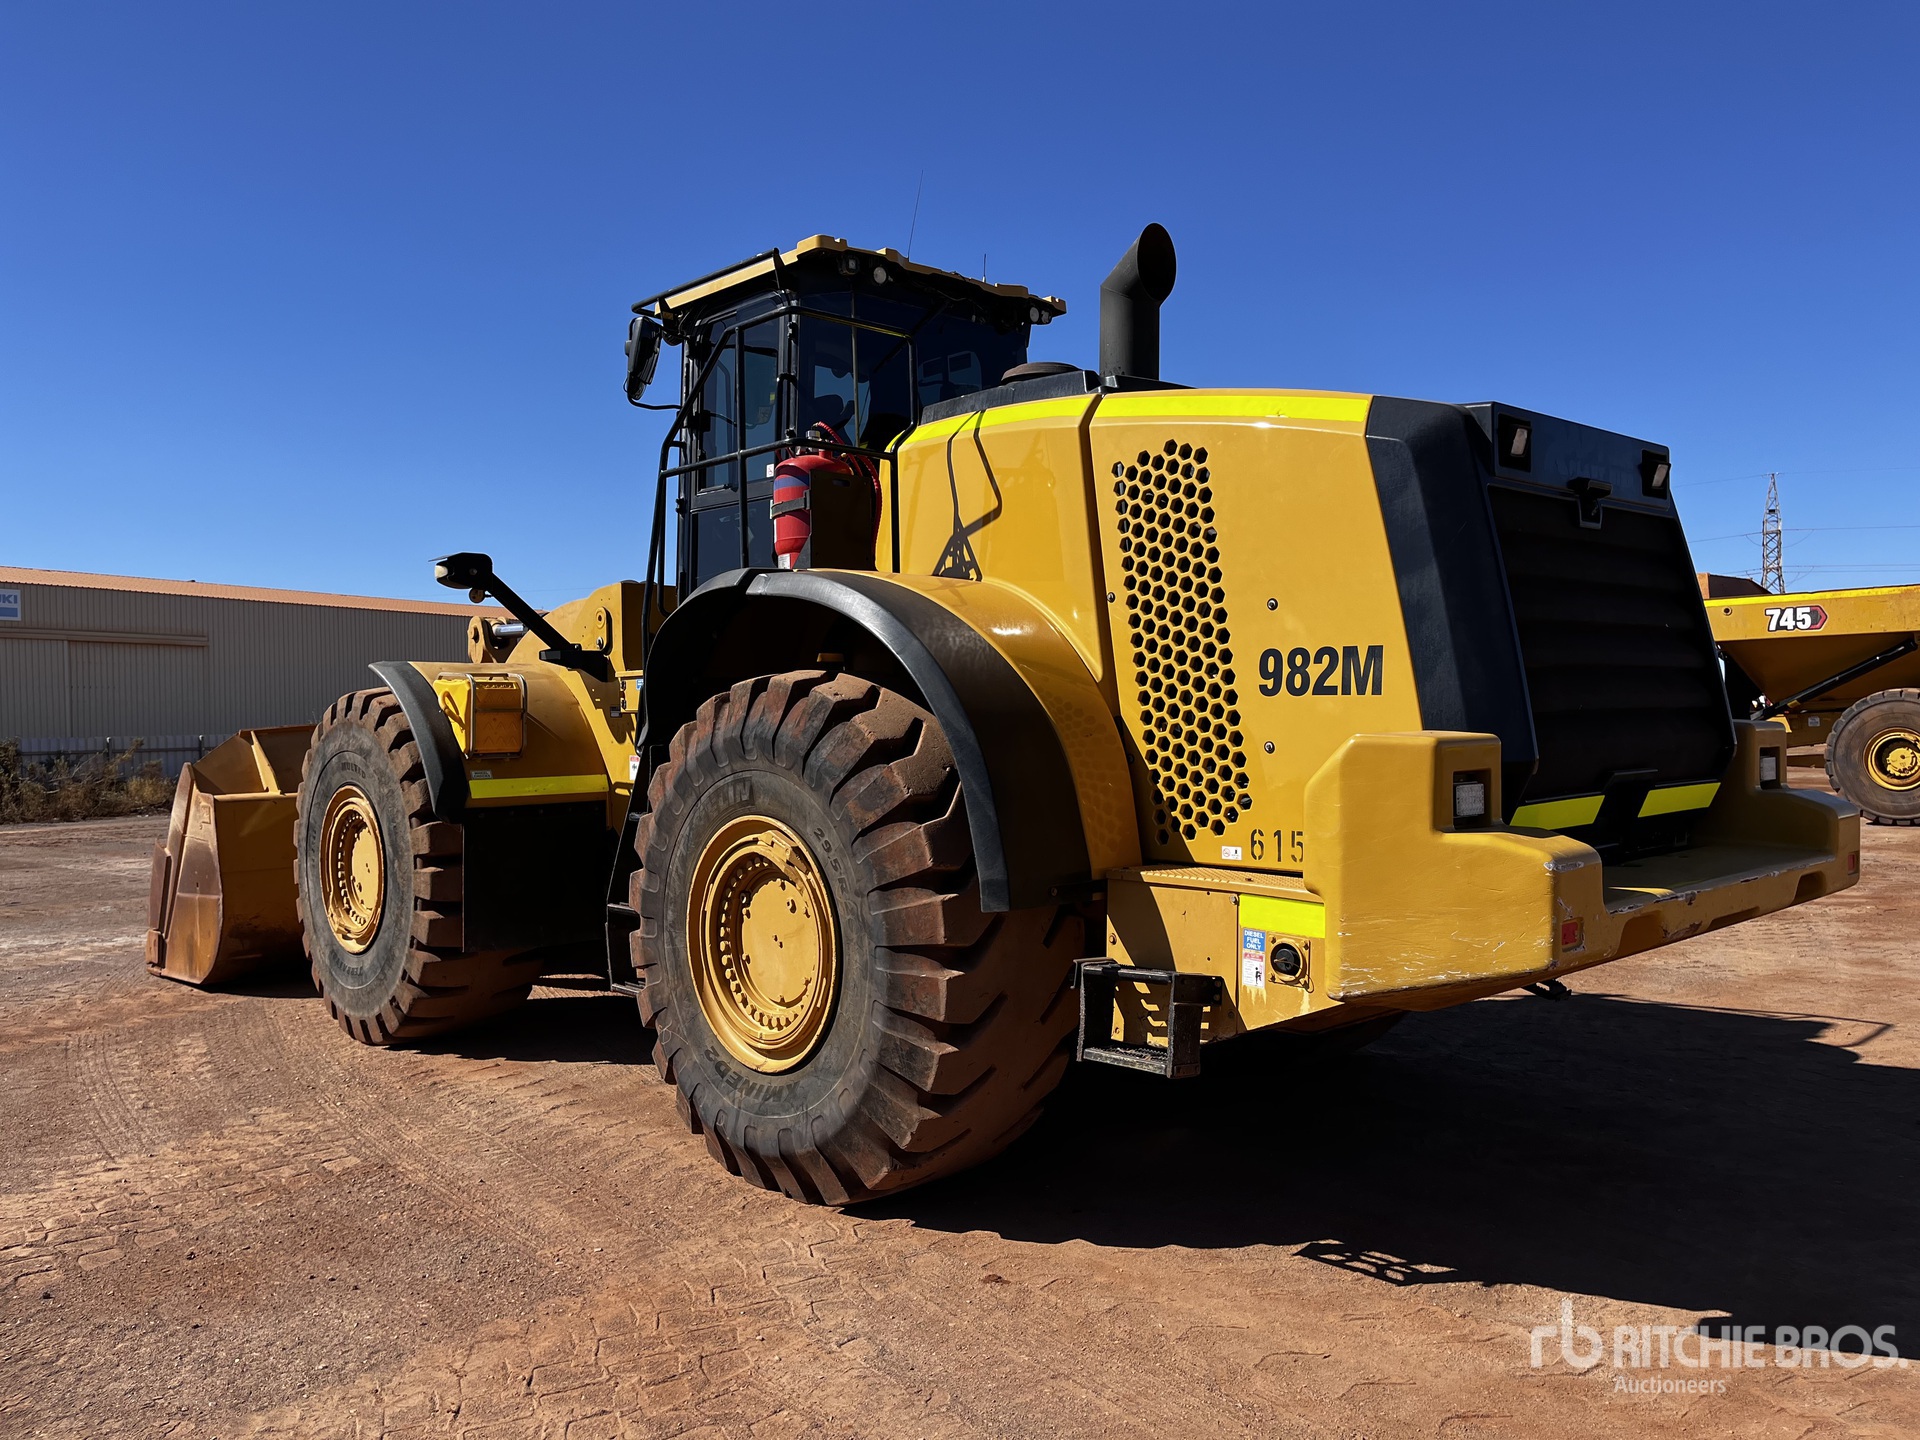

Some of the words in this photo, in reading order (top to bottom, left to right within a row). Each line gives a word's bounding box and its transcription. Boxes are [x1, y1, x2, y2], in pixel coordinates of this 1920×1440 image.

[0, 593, 18, 604] KI
[1765, 606, 1811, 631] 745
[1258, 645, 1384, 697] 982M
[1250, 828, 1304, 863] 615
[1244, 930, 1264, 939] DIESEL
[1246, 936, 1262, 944] FUEL
